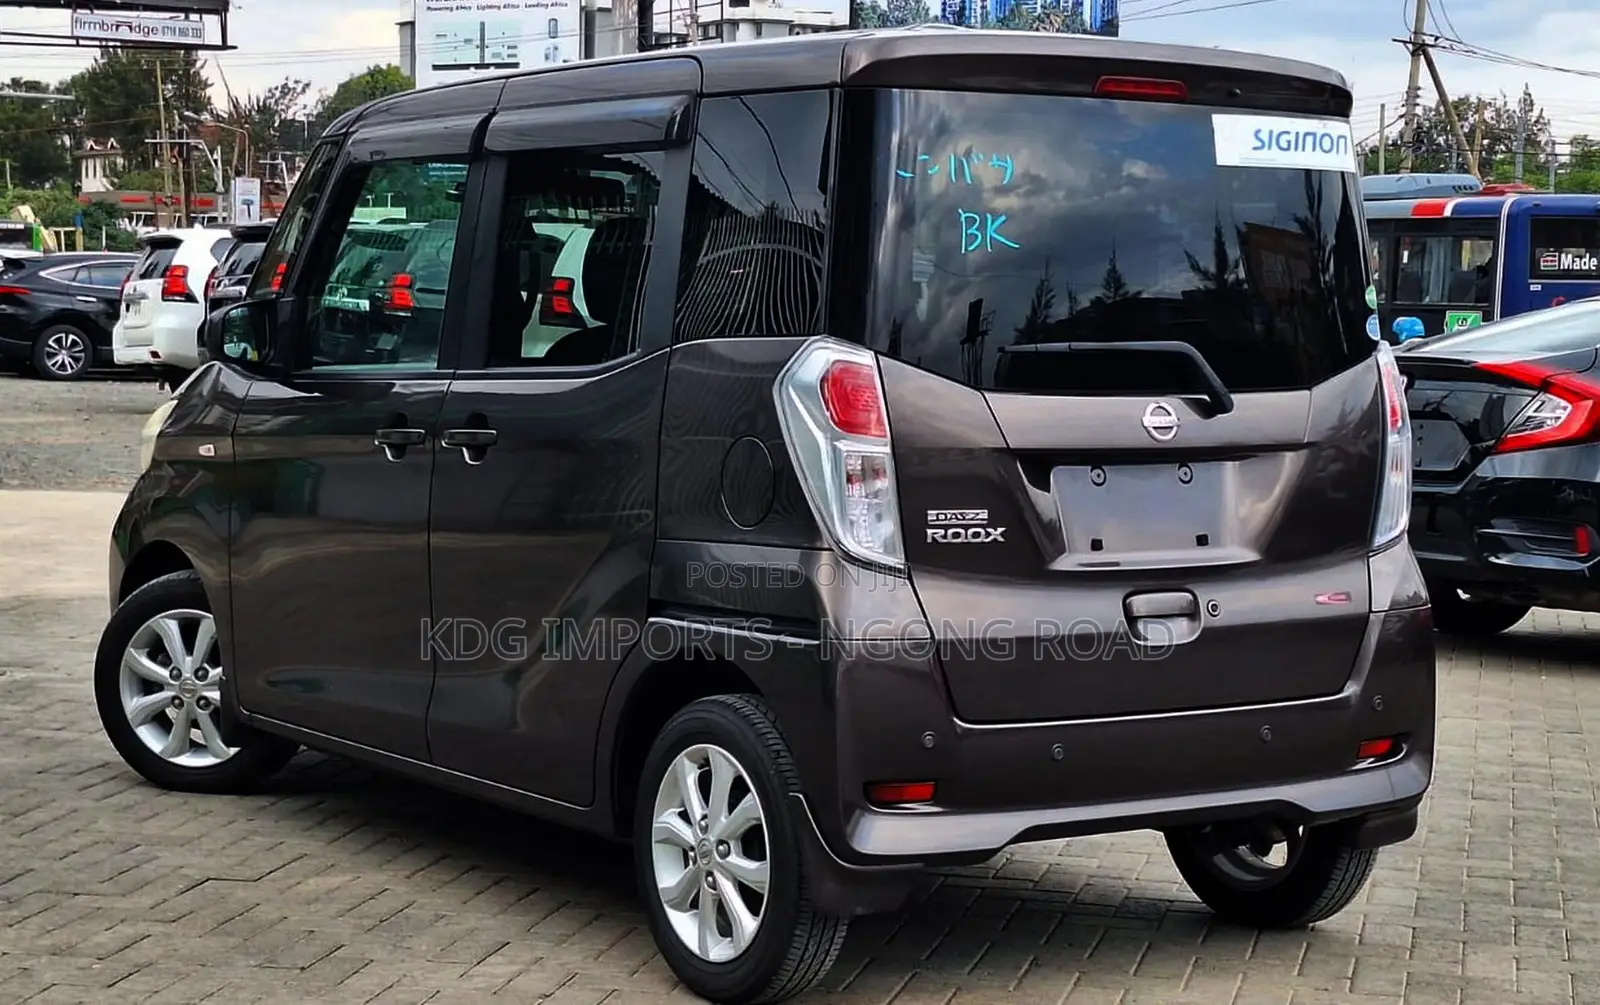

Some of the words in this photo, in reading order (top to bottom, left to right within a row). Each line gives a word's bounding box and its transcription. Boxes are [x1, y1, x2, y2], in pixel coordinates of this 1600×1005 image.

[958, 208, 1020, 254] BK
[1560, 252, 1598, 270] Made
[926, 527, 1006, 543] ROOX
